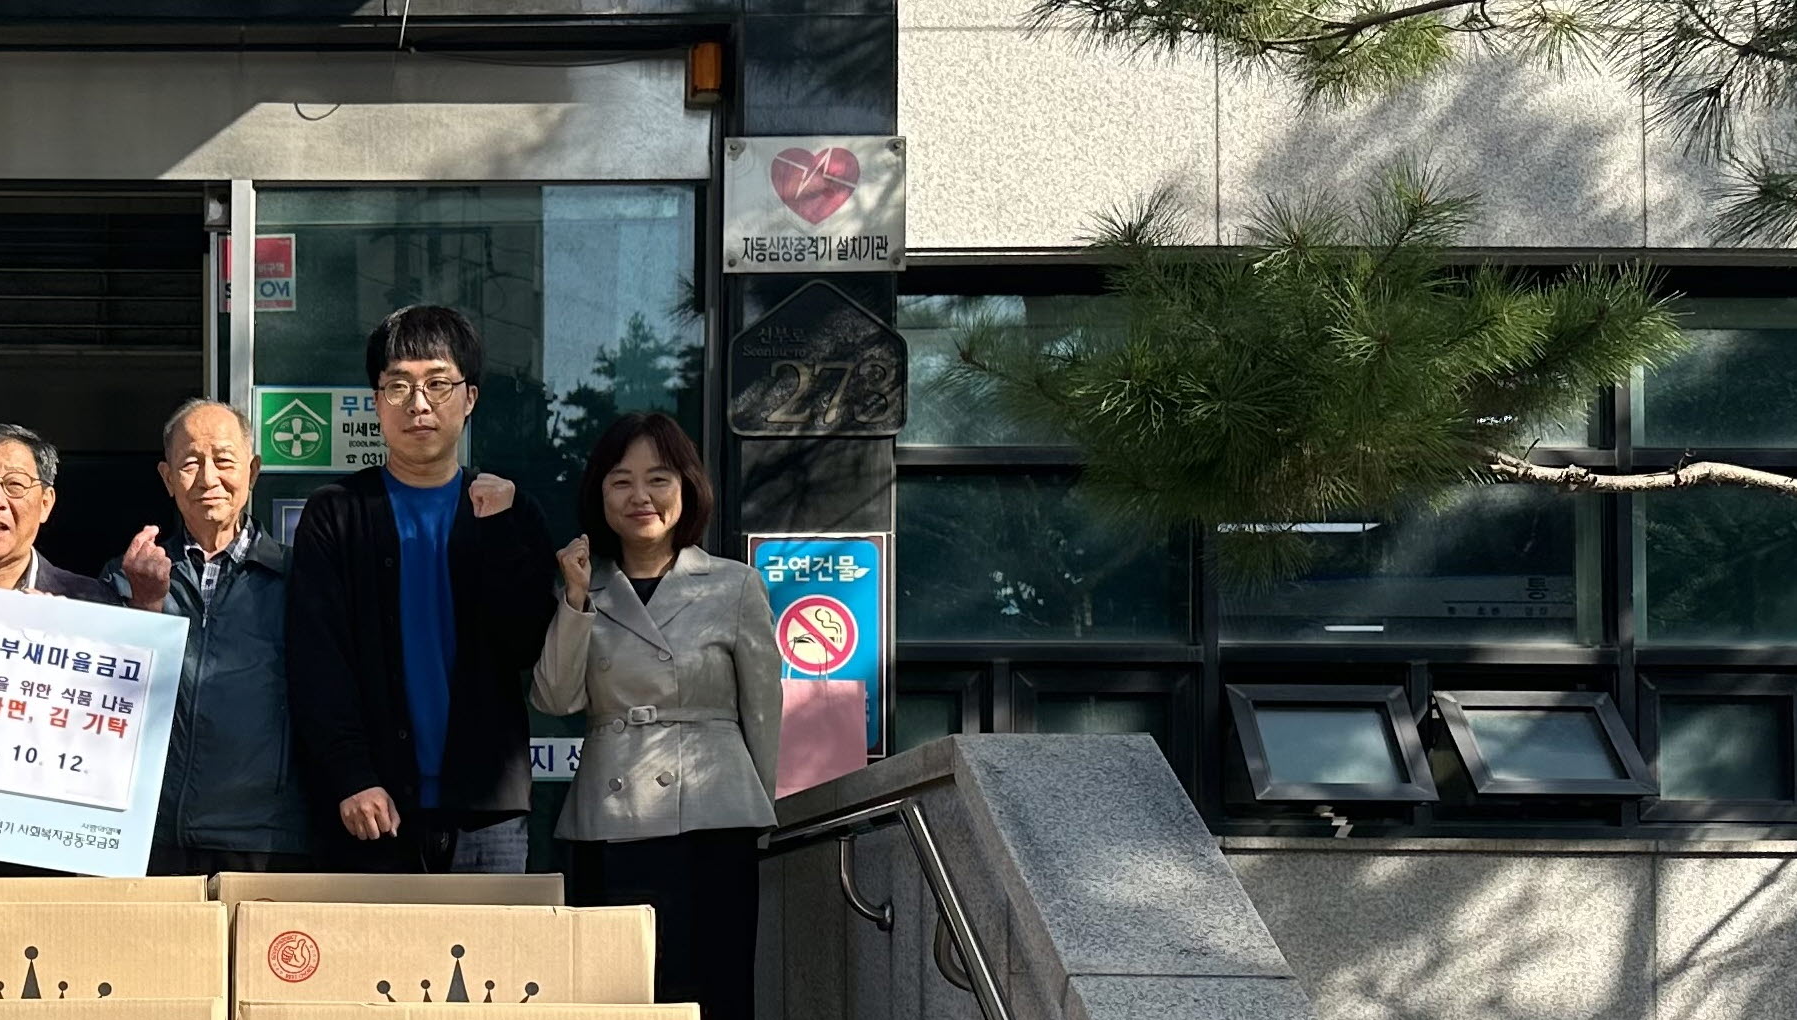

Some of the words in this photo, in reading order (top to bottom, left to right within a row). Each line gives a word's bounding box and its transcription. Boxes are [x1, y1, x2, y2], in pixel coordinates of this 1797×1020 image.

[742, 236, 832, 263] 자동심장충격기
[836, 235, 889, 262] 설치기관
[764, 360, 898, 425] 273
[764, 555, 860, 583] 금연건물
[19, 679, 51, 700] 위한
[60, 686, 93, 707] 식품
[101, 693, 134, 714] 나눔
[49, 706, 69, 728] 김
[82, 712, 129, 739] 기탁
